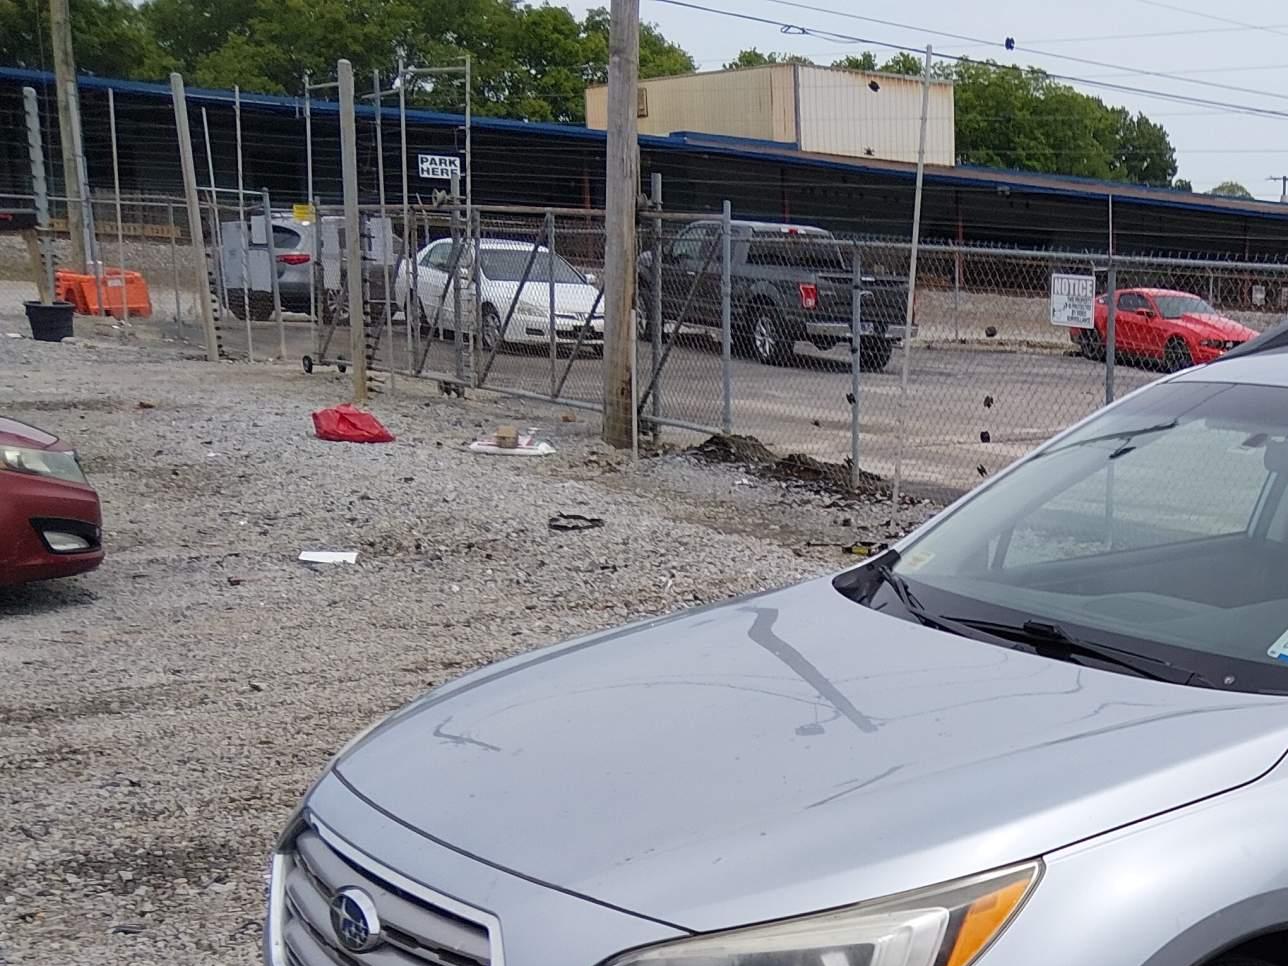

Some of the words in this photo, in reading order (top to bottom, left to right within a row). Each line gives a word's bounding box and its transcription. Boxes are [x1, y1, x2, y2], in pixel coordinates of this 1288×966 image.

[420, 156, 458, 168] PARK
[421, 167, 458, 177] HERE
[1054, 278, 1093, 297] NOTICE
